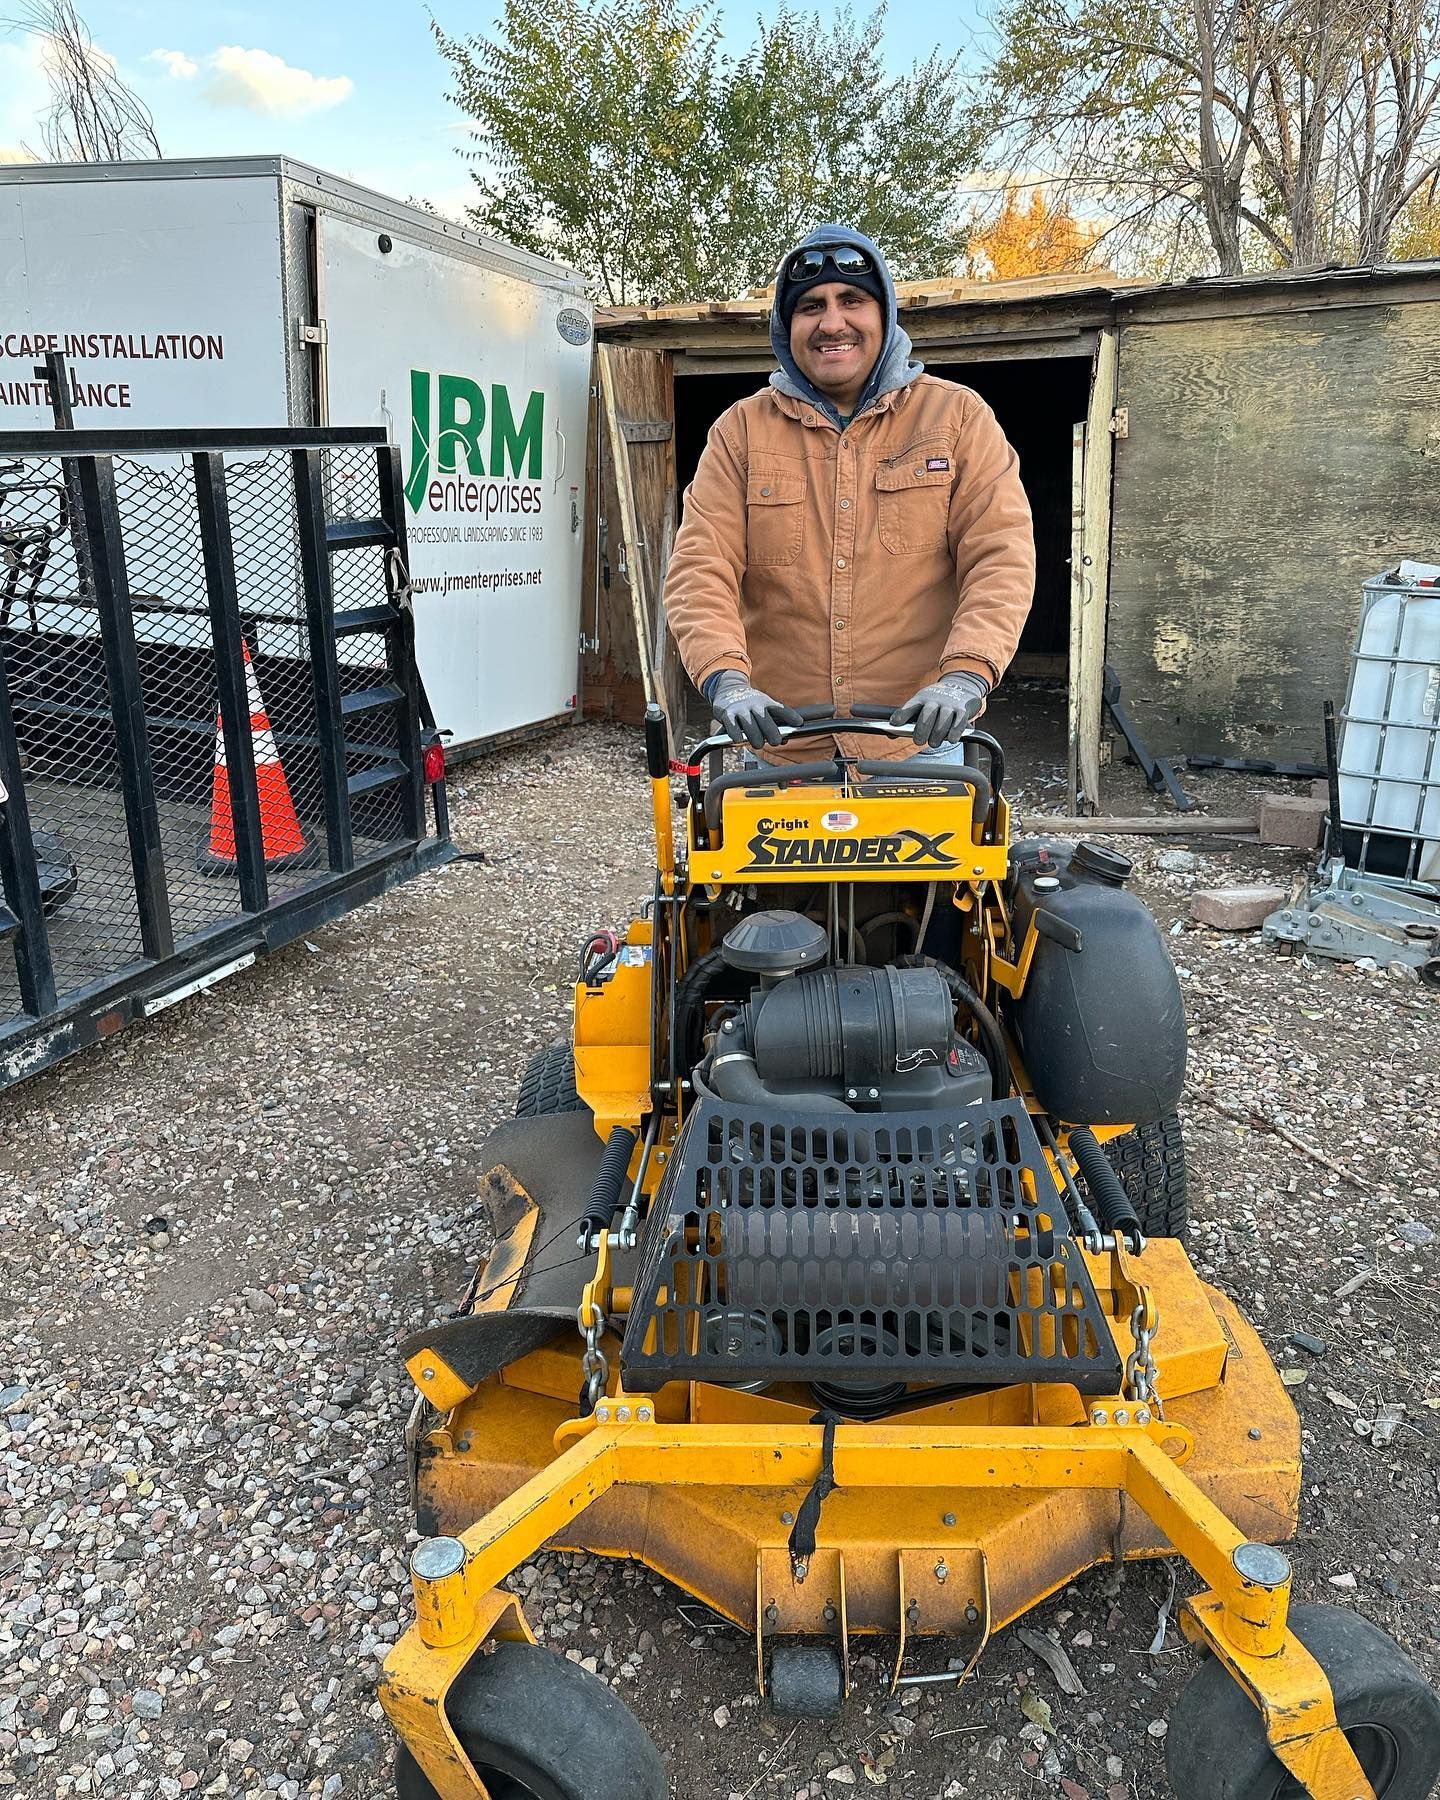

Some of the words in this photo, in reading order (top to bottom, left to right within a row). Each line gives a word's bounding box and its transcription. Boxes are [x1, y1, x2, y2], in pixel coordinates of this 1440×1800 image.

[64, 334, 224, 359] INSTALLATION
[404, 369, 545, 515] JRM
[428, 474, 542, 521] enterprises
[407, 527, 462, 543] PROFESSIONAL
[464, 527, 508, 542] LANDSCAPING
[509, 527, 527, 541] SINCE
[529, 527, 543, 541] 1983
[748, 834, 902, 865] STANDER
